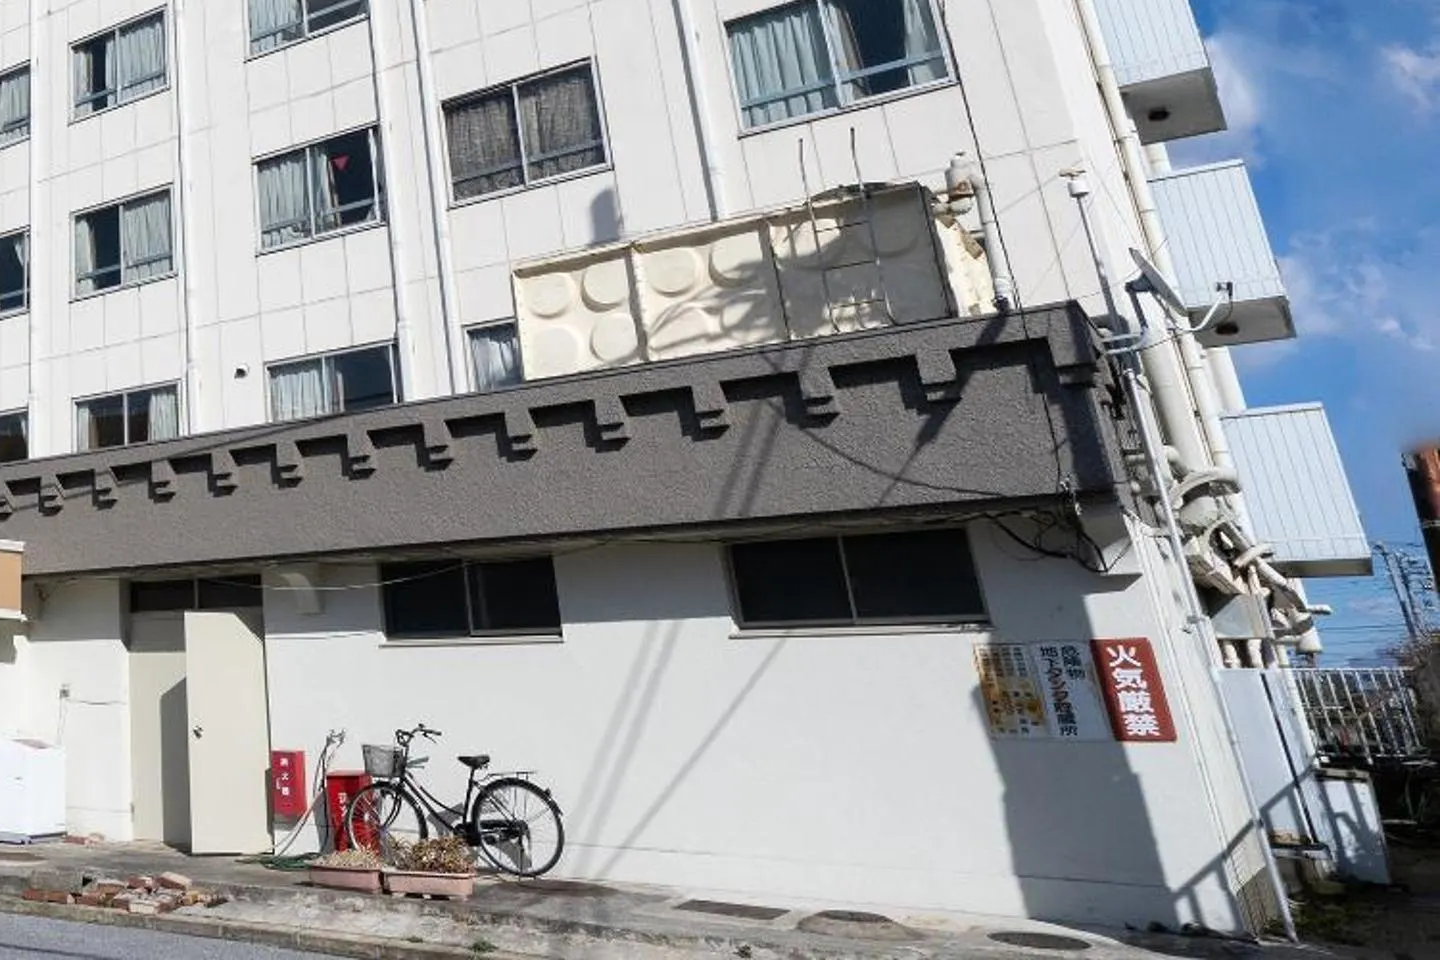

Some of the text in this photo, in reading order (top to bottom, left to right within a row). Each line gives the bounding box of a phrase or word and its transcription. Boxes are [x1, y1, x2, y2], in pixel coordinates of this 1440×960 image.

[1040, 645, 1078, 736] 地下タンク貯蔵所
[1061, 645, 1086, 681] 危険物
[1106, 644, 1161, 736] 火気厳禁
